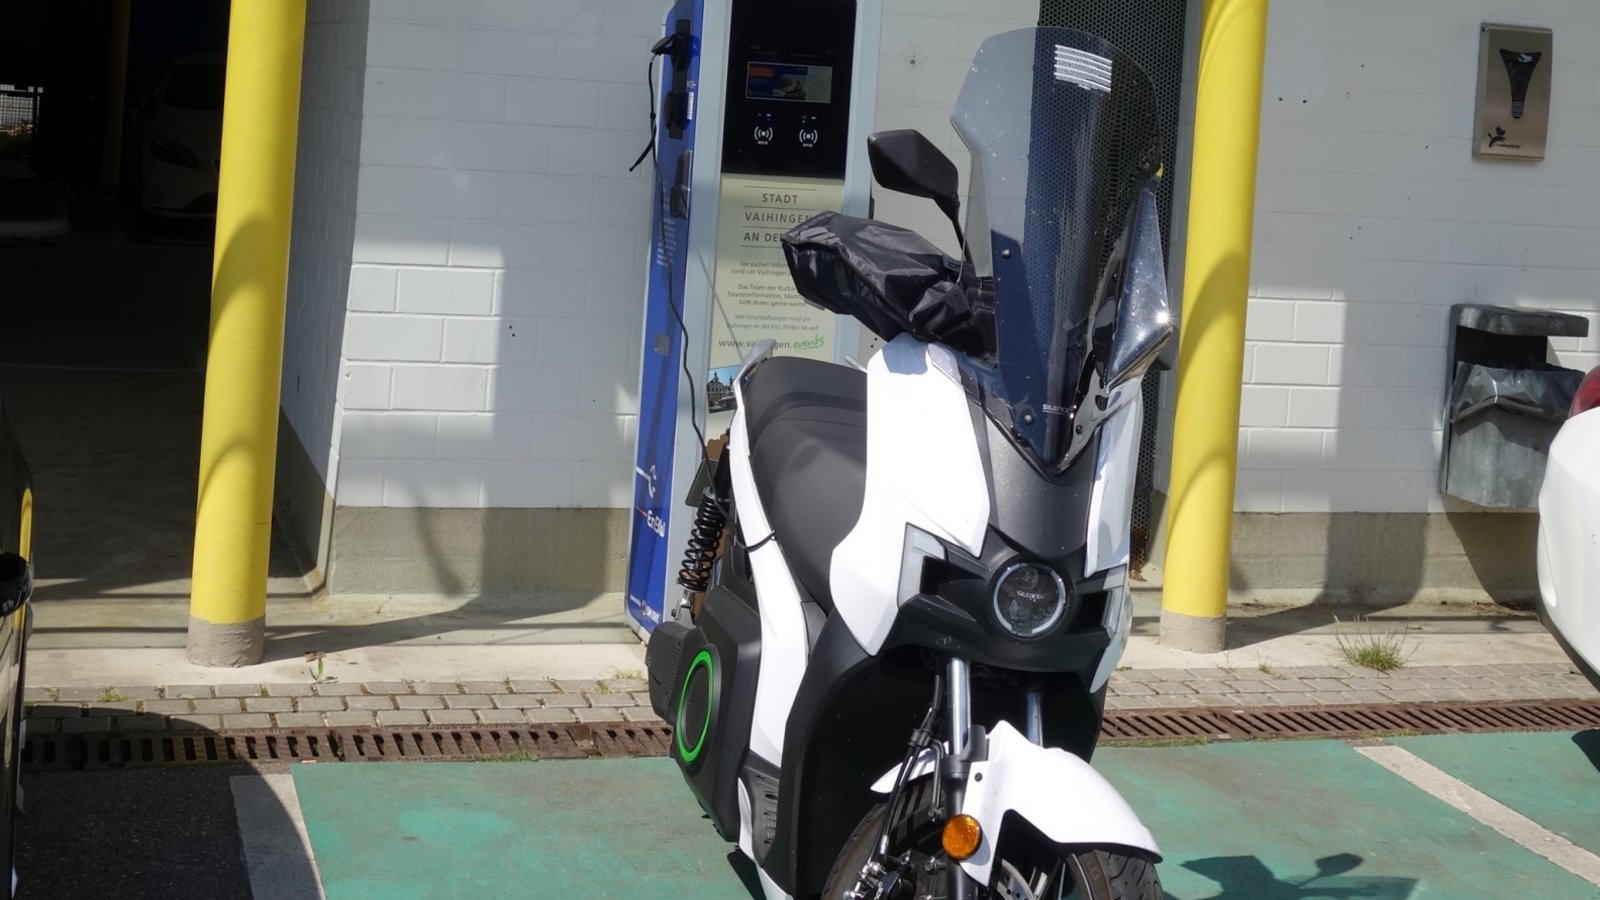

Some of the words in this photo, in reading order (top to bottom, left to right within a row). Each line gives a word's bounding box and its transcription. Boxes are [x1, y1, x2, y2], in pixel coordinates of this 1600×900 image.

[762, 193, 798, 204] STADT
[744, 232, 760, 242] AN
[647, 510, 665, 538] EnBW
